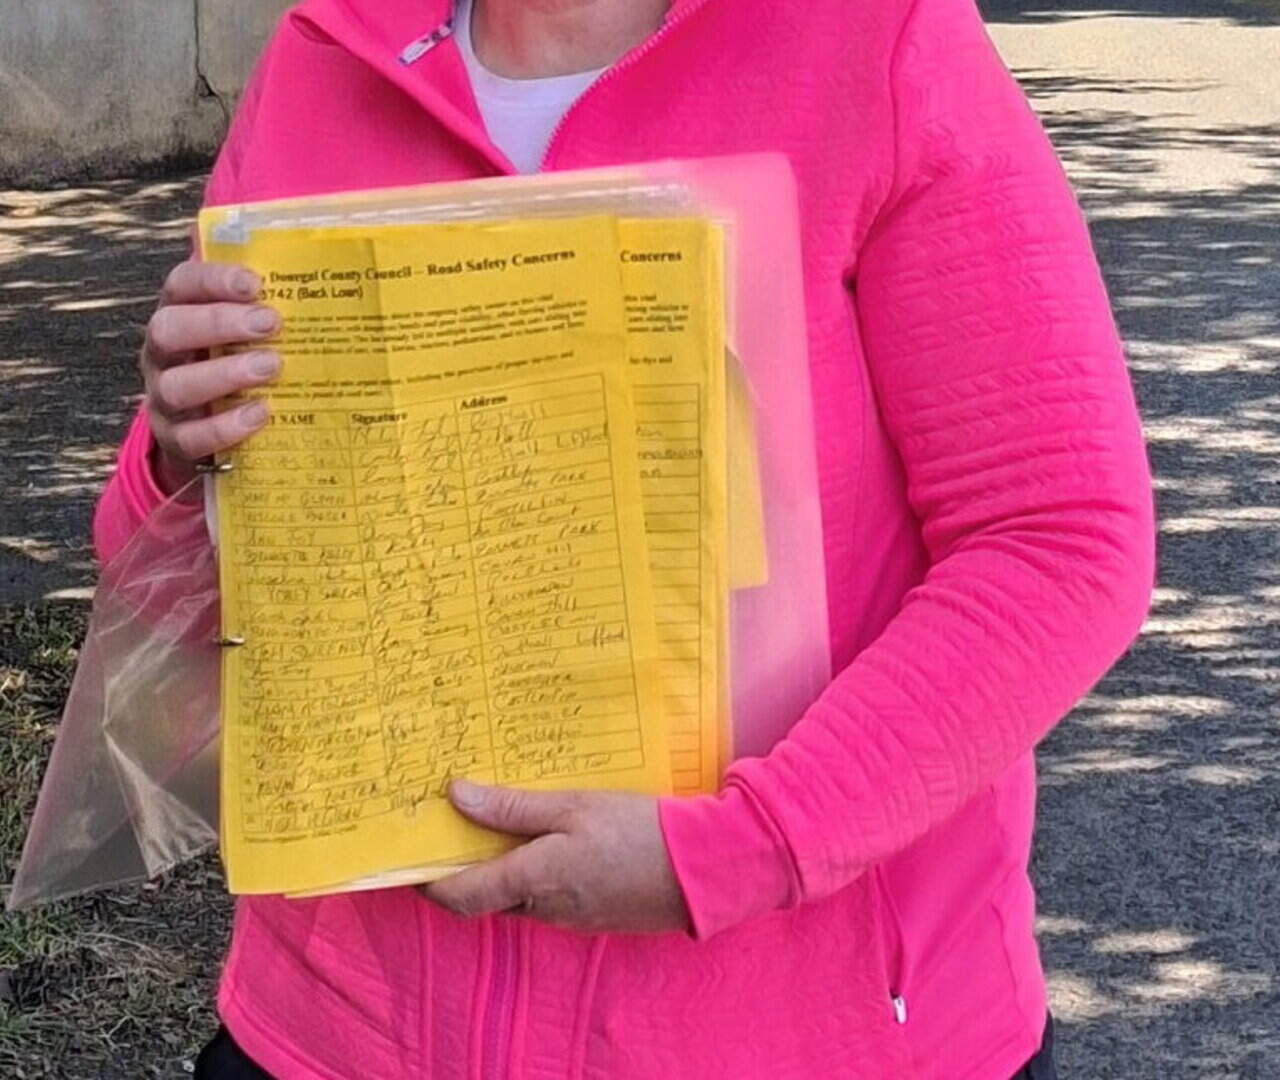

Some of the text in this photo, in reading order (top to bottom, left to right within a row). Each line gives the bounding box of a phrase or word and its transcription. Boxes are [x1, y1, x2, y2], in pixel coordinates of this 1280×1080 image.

[620, 249, 682, 263] Concerns
[270, 270, 318, 284] Donegal
[321, 270, 361, 283] County
[365, 266, 412, 281] Council
[427, 262, 463, 276] Road
[466, 257, 507, 271] Safety
[512, 249, 575, 267] Concerns
[460, 394, 509, 411] Address
[280, 413, 316, 425] NAME
[351, 411, 408, 425] Signature
